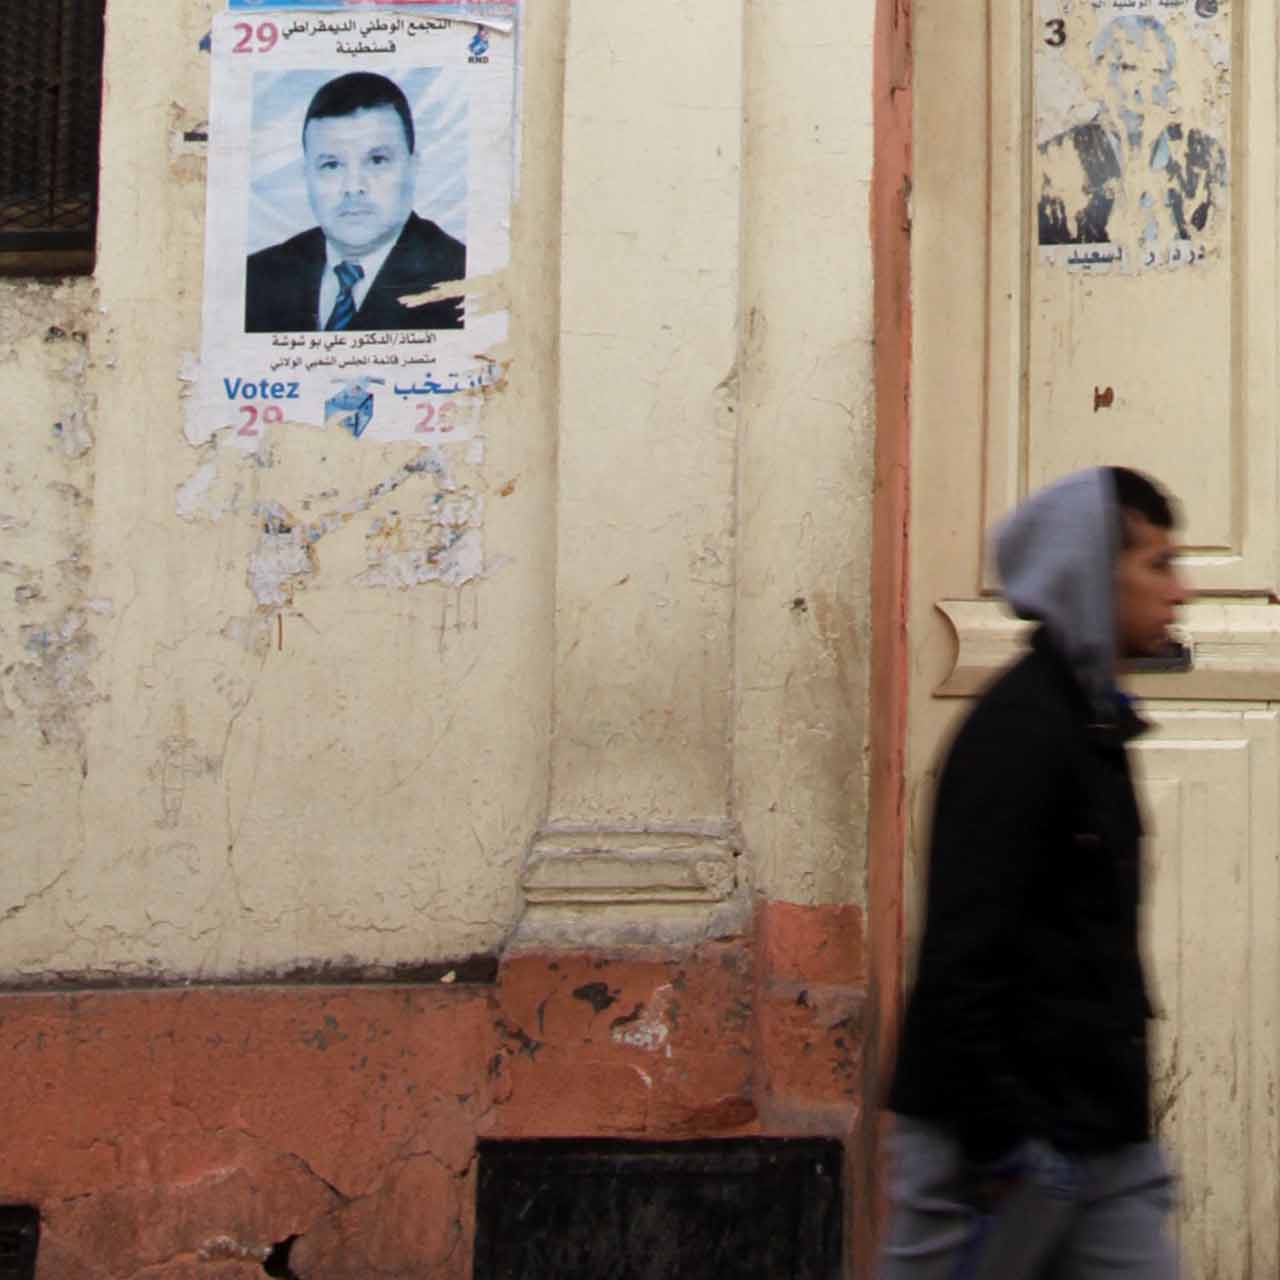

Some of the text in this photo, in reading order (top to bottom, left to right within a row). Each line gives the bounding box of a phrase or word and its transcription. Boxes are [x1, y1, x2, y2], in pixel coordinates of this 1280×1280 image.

[232, 21, 279, 54] 29
[281, 19, 357, 40] الديمقراطي
[359, 18, 405, 39] الوطني
[1044, 18, 1067, 48] 3
[335, 40, 397, 57] قسنطينة
[324, 335, 346, 352] علي
[224, 377, 300, 401] Votez
